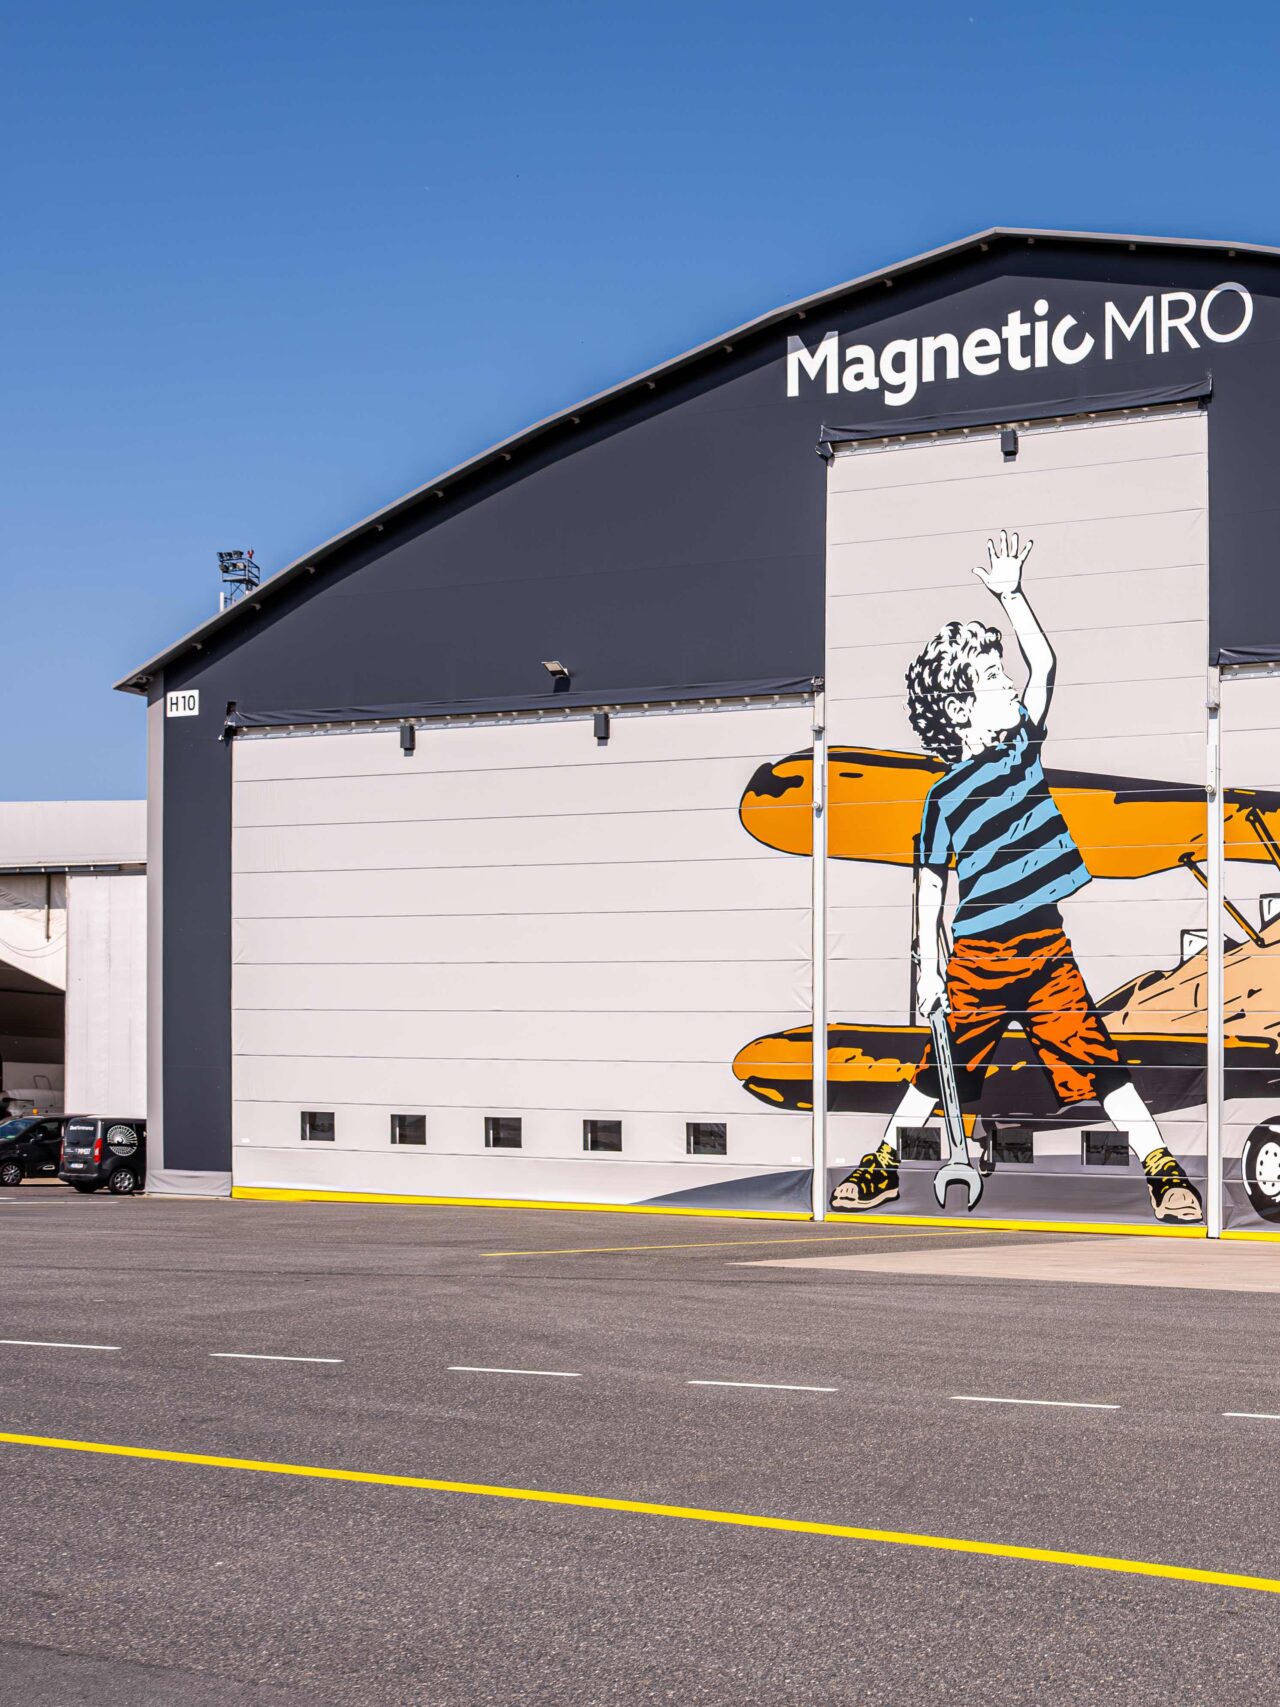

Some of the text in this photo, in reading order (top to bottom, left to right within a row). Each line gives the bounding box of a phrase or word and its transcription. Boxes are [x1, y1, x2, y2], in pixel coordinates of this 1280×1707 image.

[786, 281, 1254, 407] Magnetic MRO
[170, 695, 195, 712] H10
